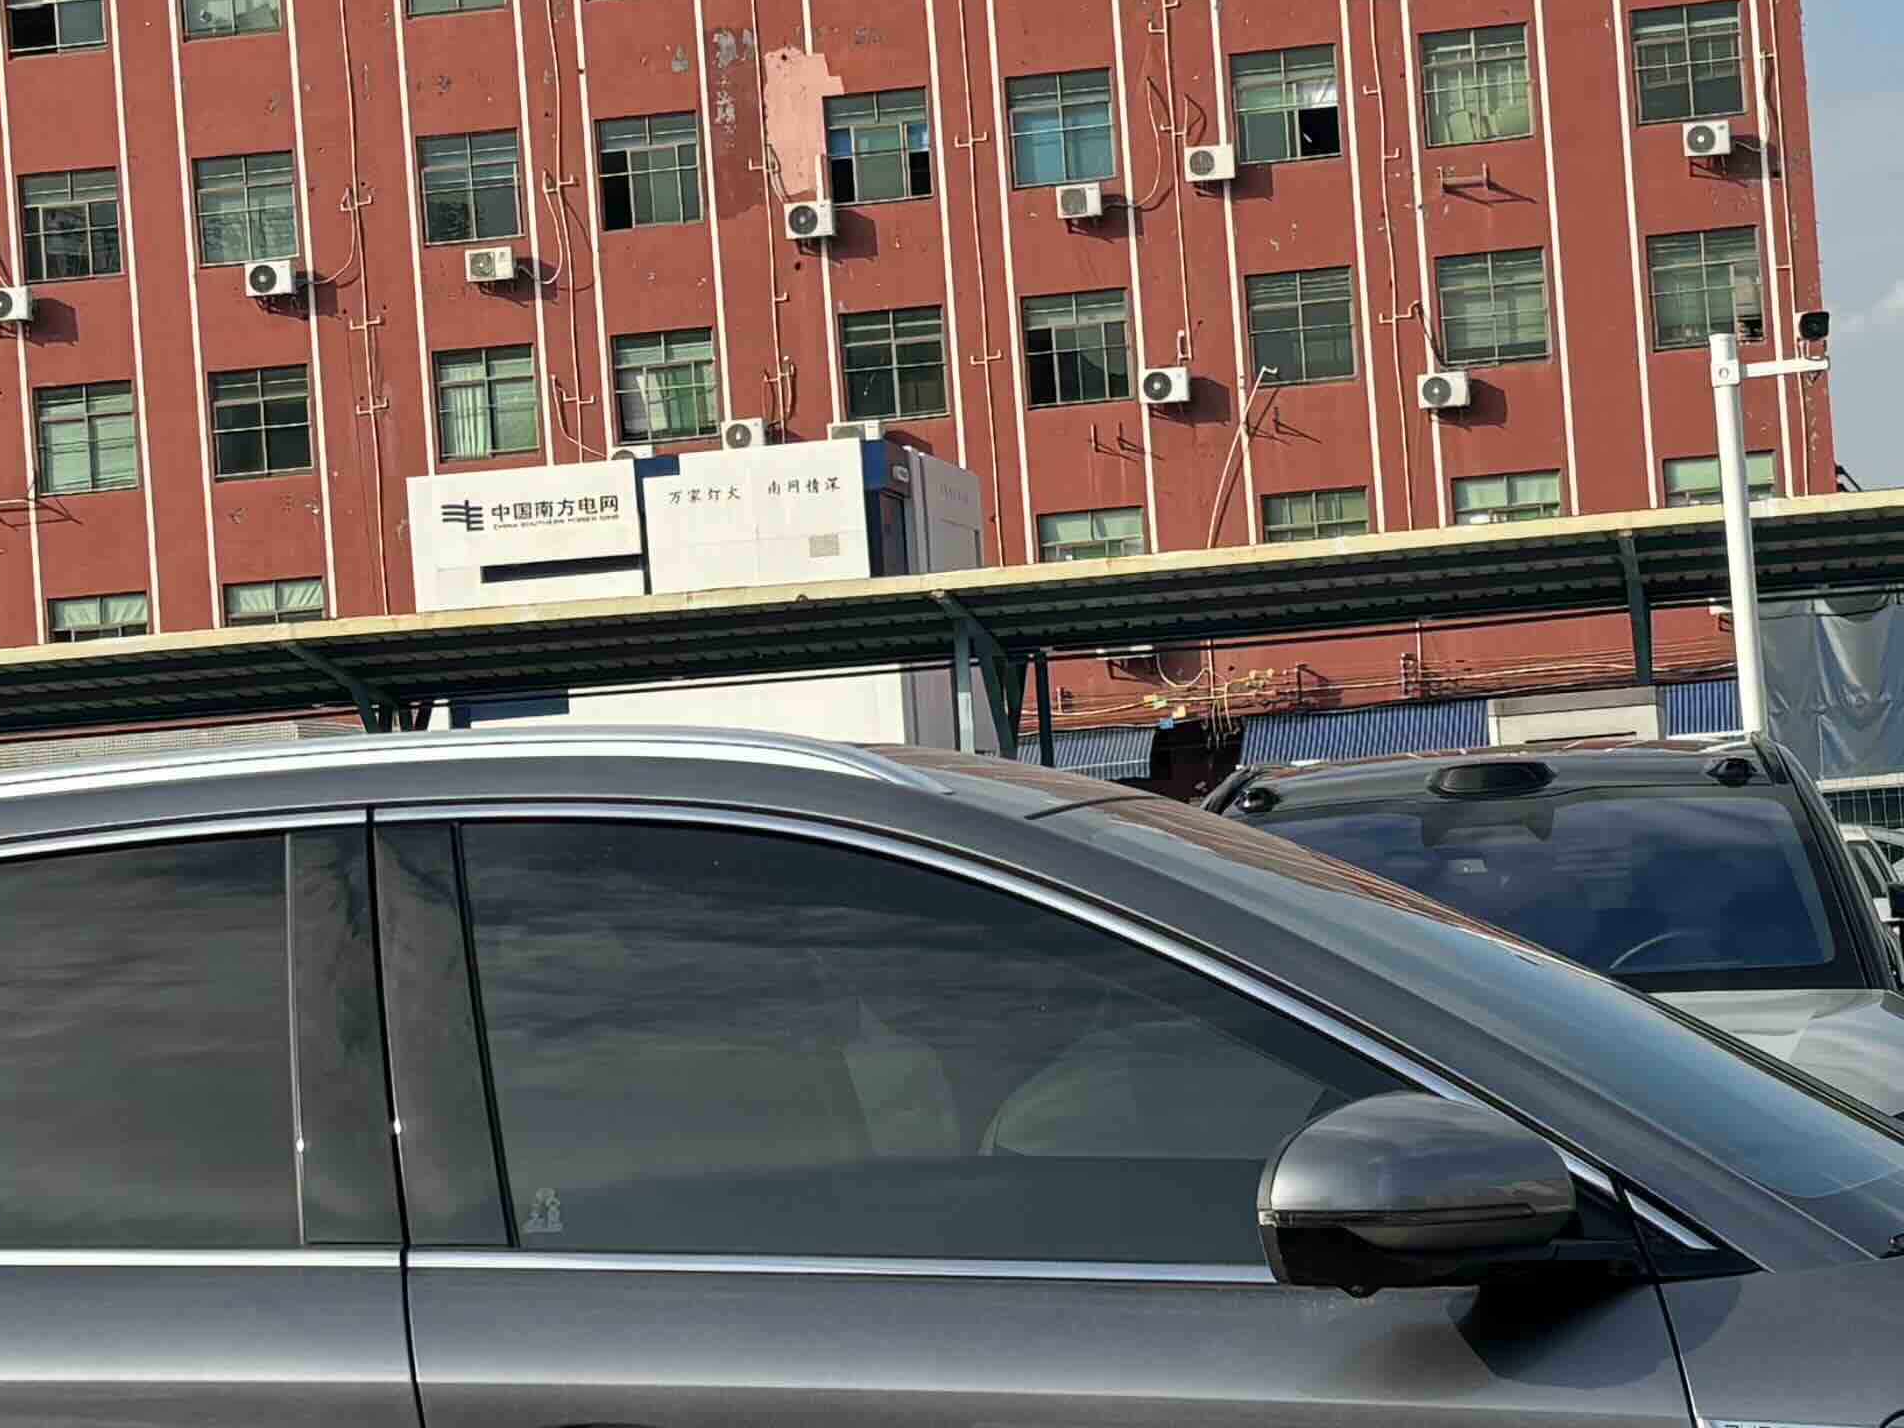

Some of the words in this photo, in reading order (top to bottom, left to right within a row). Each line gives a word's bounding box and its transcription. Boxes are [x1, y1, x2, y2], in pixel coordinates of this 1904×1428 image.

[491, 494, 619, 522] 中国南方电网
